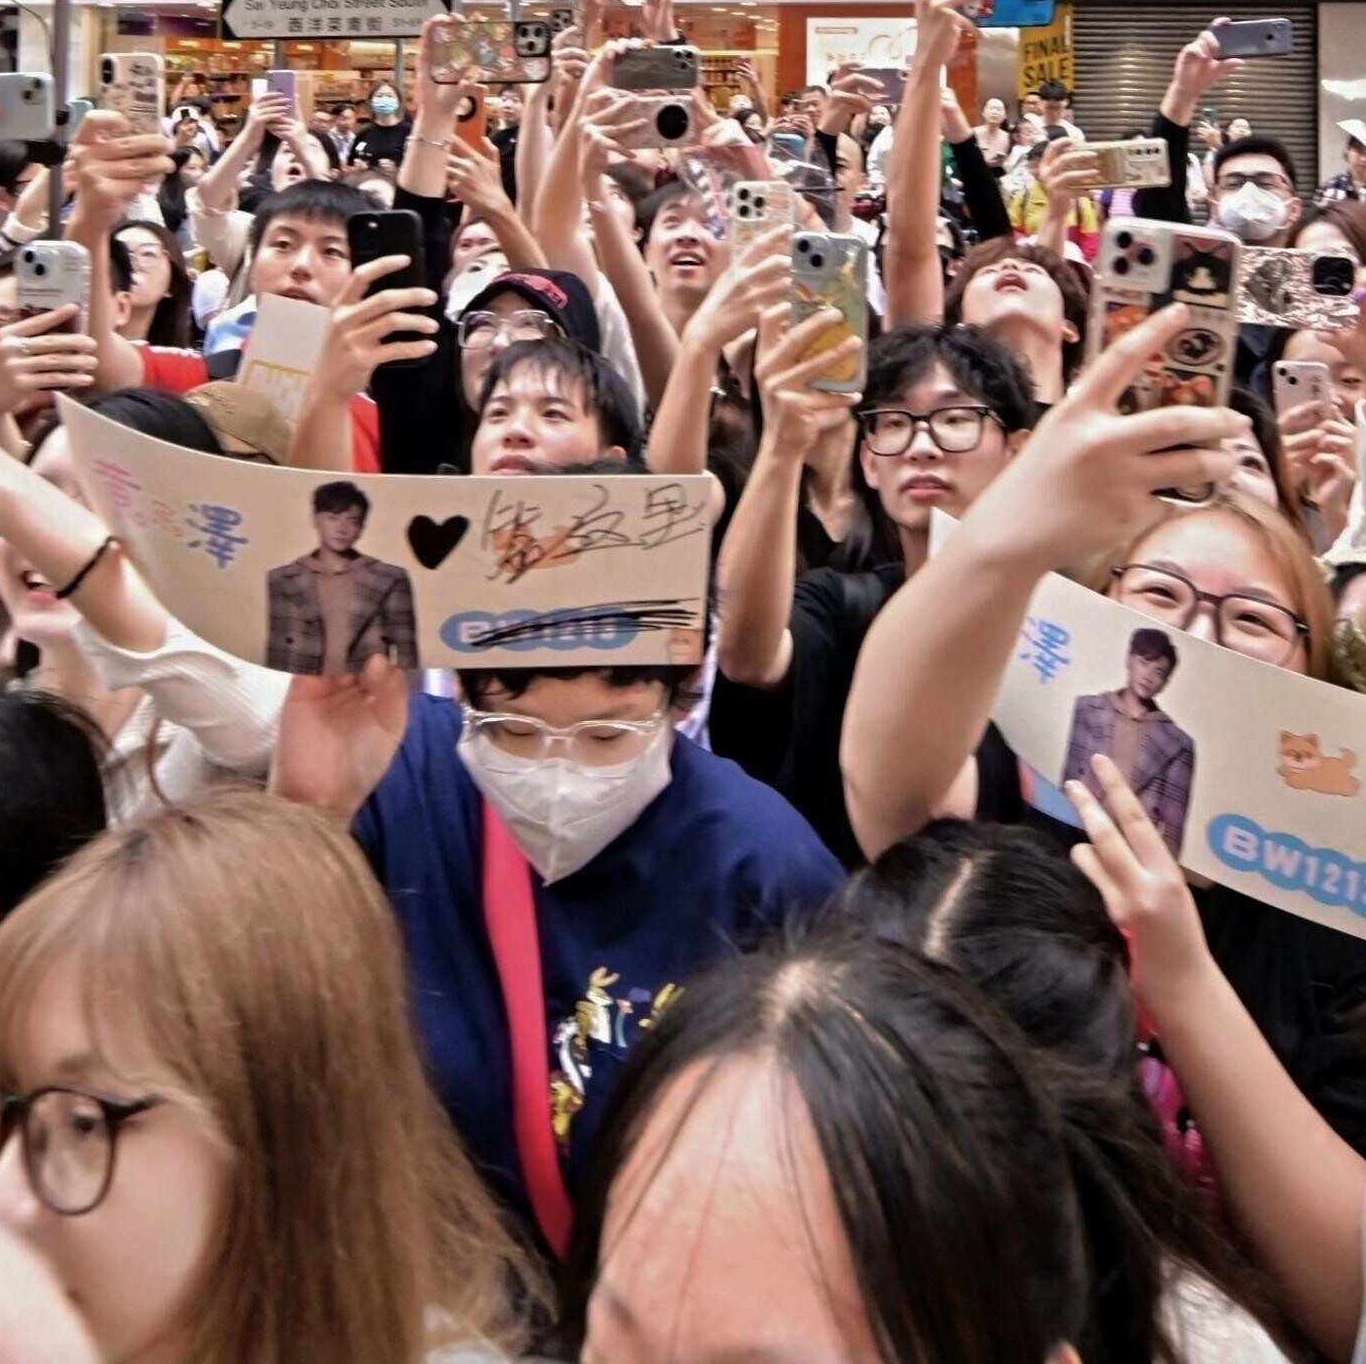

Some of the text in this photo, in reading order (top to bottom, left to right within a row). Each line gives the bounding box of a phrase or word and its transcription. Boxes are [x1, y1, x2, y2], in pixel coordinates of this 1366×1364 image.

[244, 0, 265, 11] Sai
[1023, 36, 1071, 62] FINAL
[1023, 56, 1070, 88] SALE
